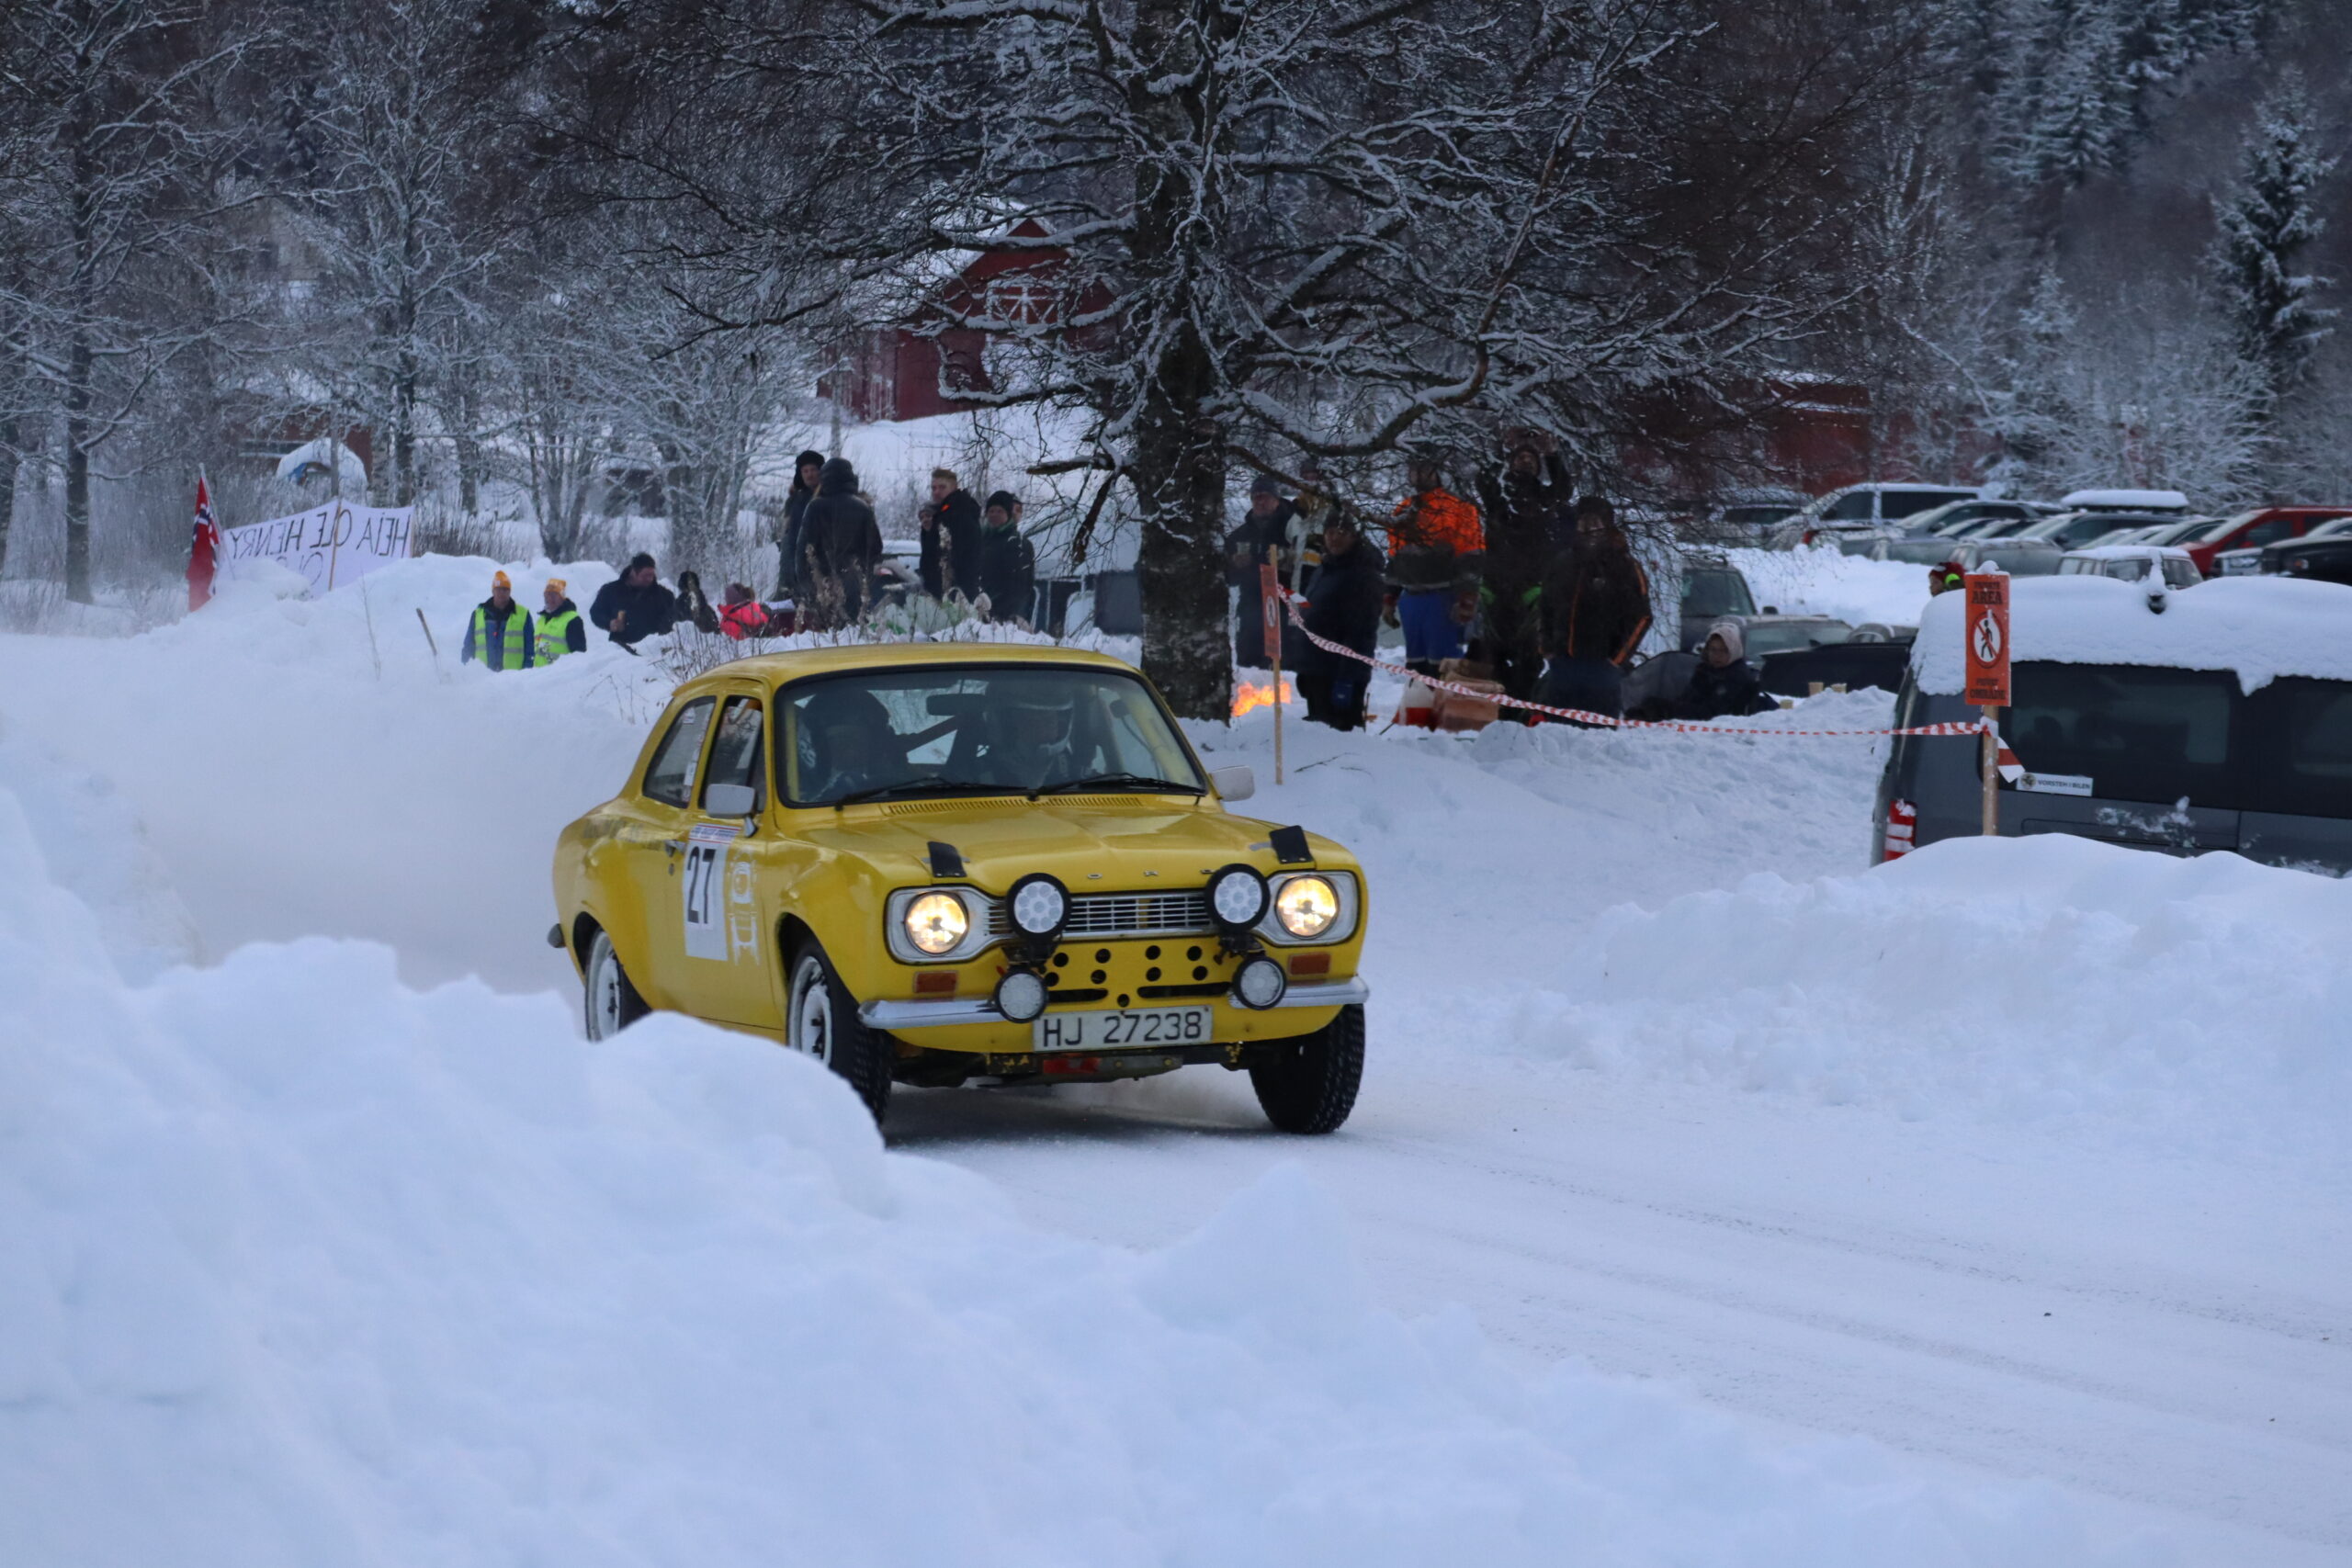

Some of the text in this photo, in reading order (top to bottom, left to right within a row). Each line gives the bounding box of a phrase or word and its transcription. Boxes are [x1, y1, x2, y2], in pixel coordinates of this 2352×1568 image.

[1971, 591, 2003, 604] AREA
[687, 846, 717, 924] 27
[1044, 1011, 1202, 1047] HJ 27238
